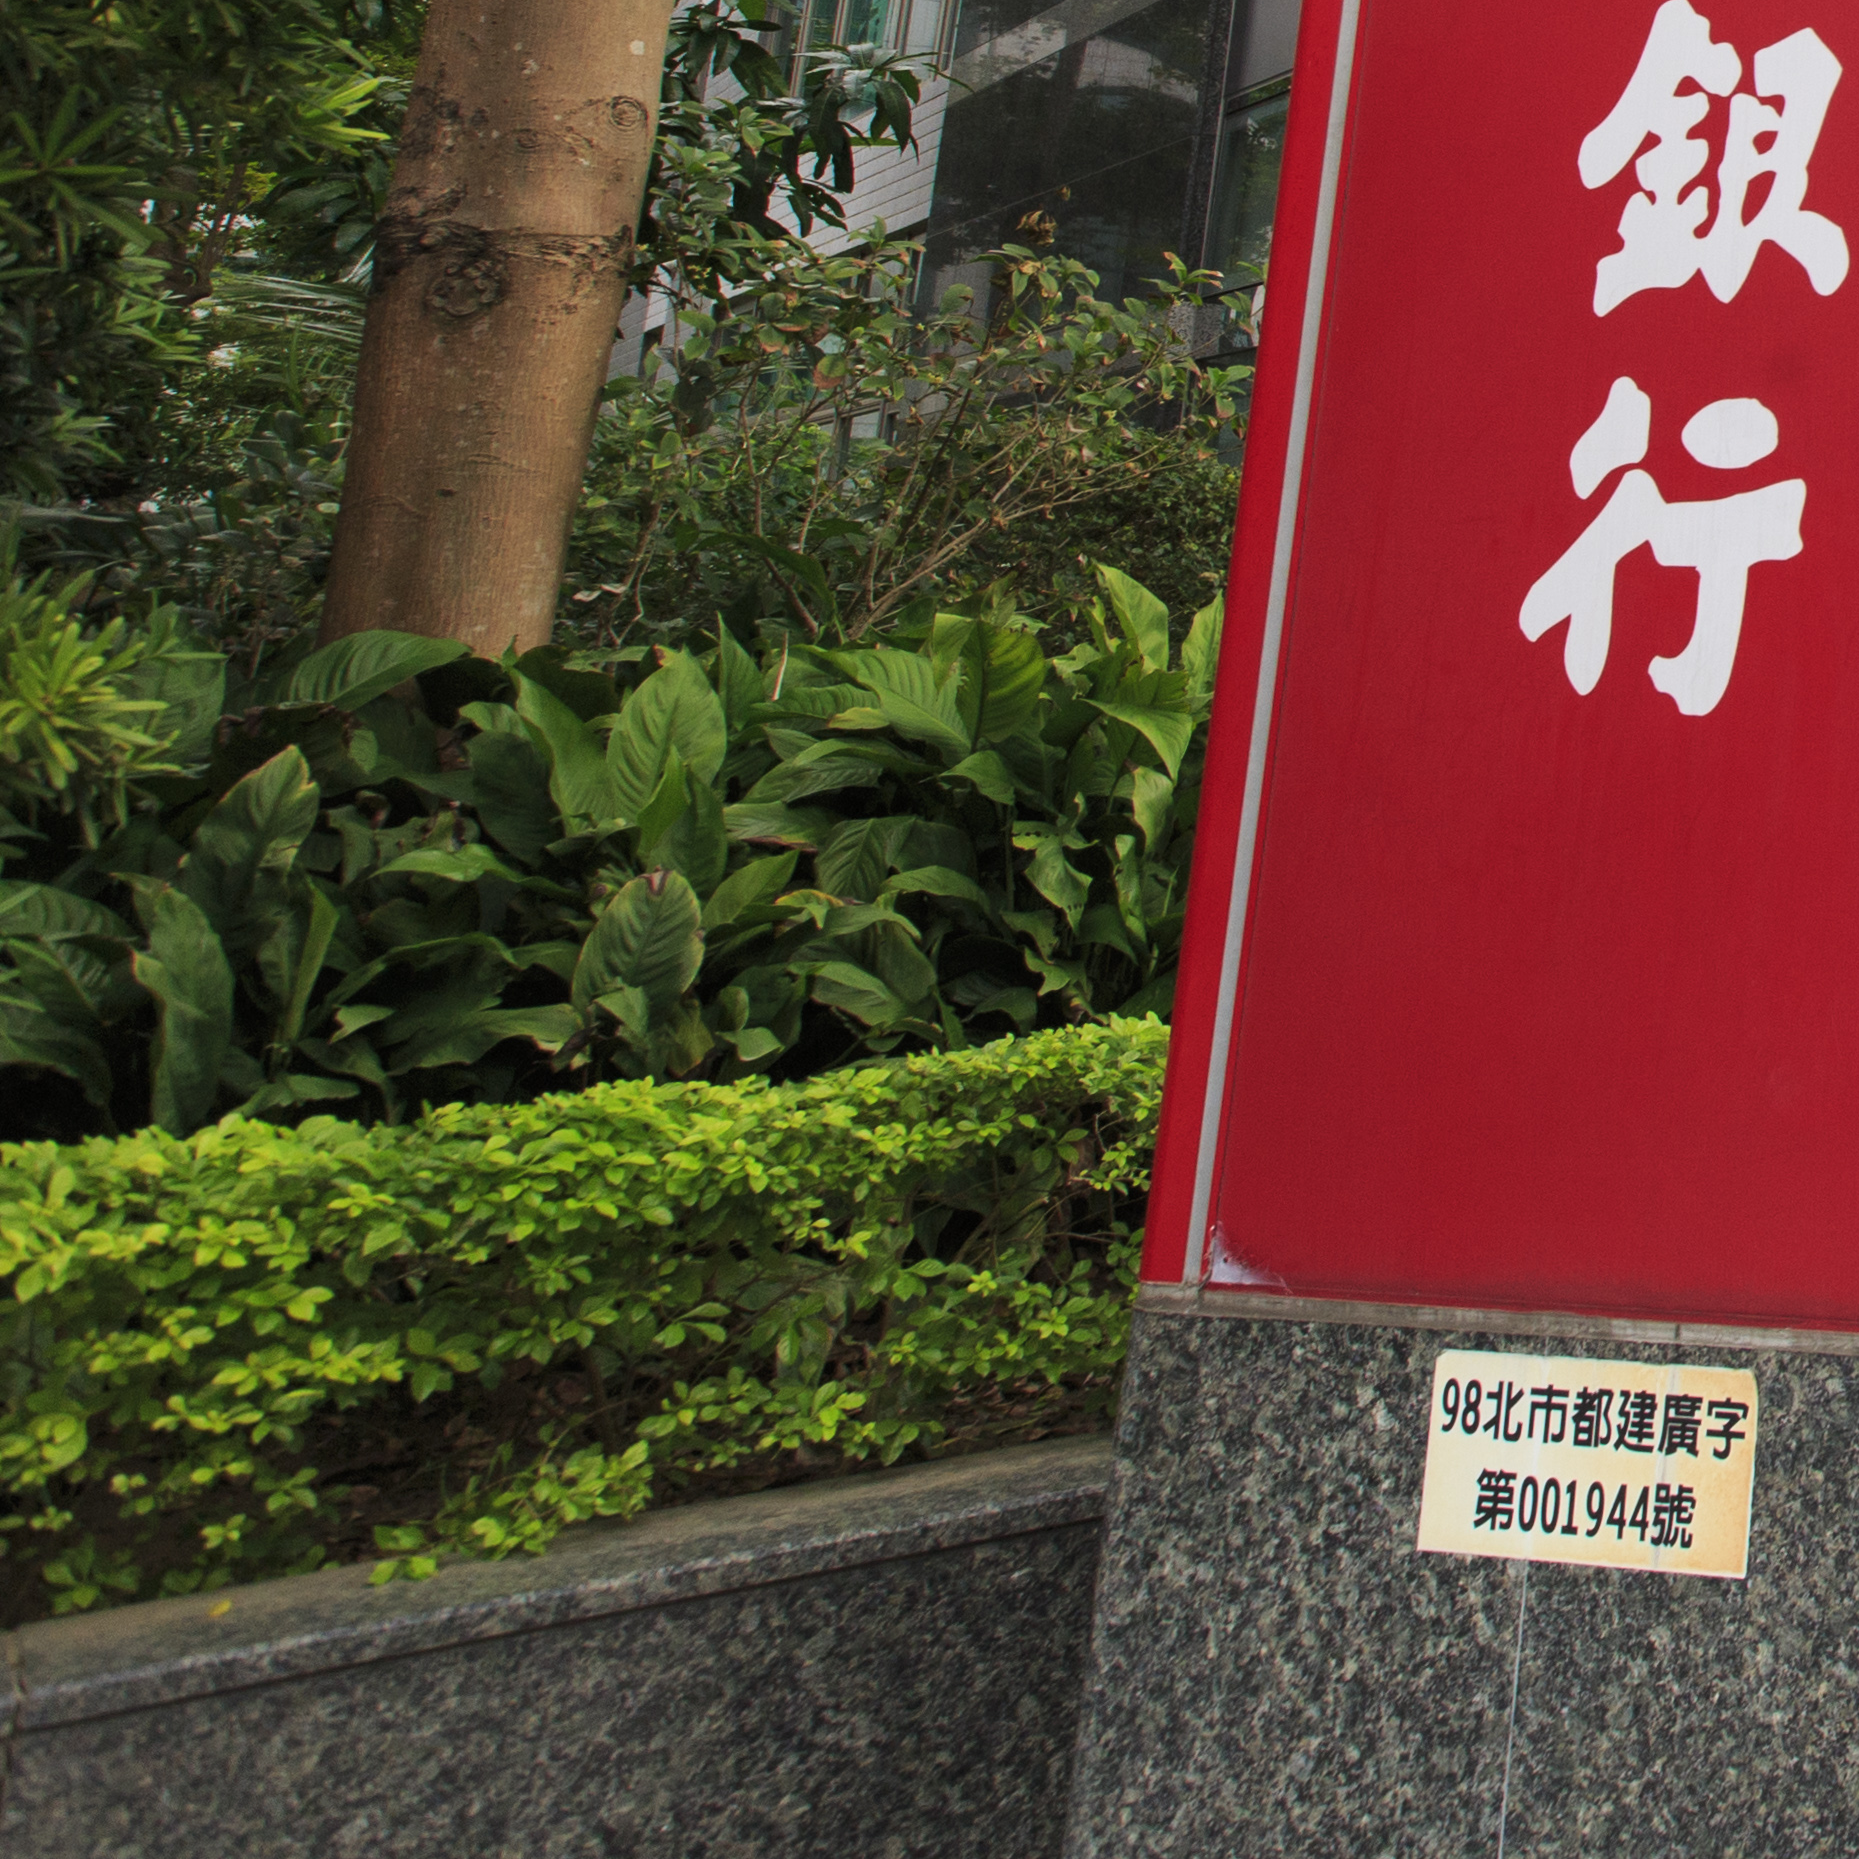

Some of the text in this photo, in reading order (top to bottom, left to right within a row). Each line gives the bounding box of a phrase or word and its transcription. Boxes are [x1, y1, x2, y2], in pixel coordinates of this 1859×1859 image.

[1440, 1377, 1750, 1461] 98北市都建廣字
[1473, 1467, 1697, 1549] 第001944號
